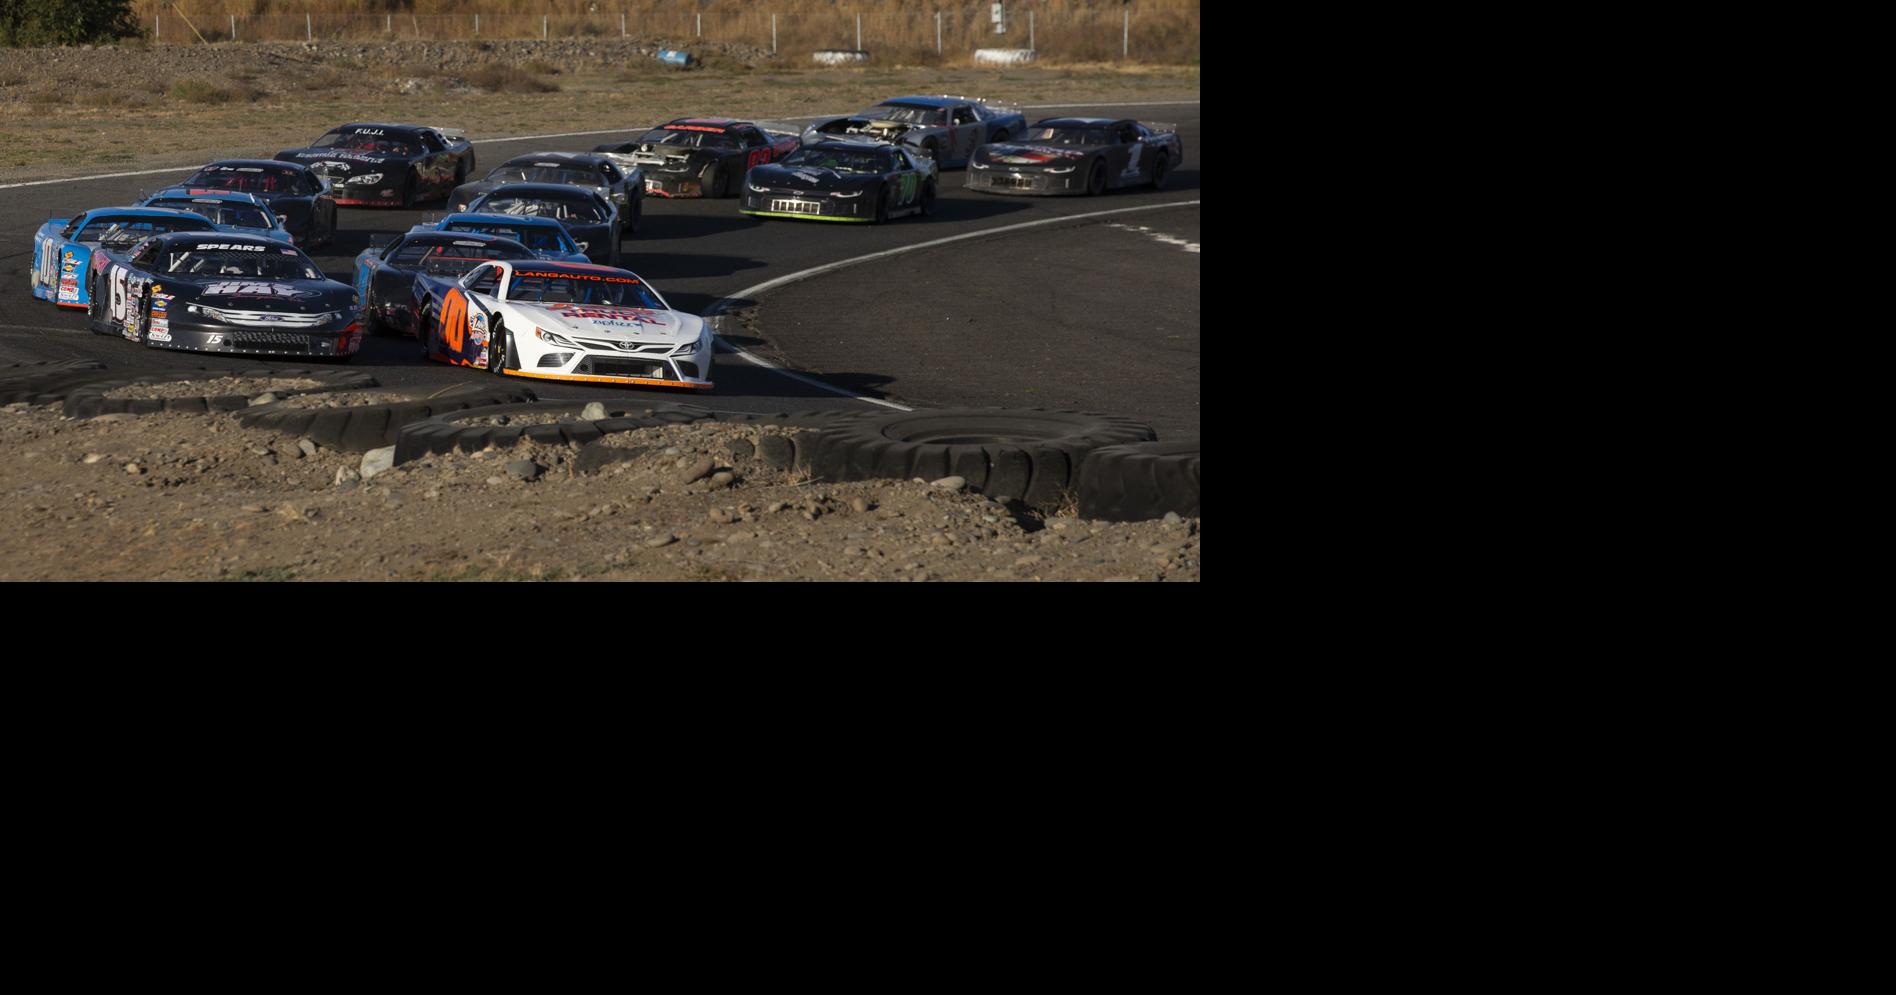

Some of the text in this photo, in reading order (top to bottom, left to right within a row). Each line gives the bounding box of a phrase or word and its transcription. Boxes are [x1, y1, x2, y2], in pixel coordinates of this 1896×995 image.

[196, 243, 267, 252] SPEARS
[110, 264, 128, 322] 15
[206, 335, 223, 344] 15
